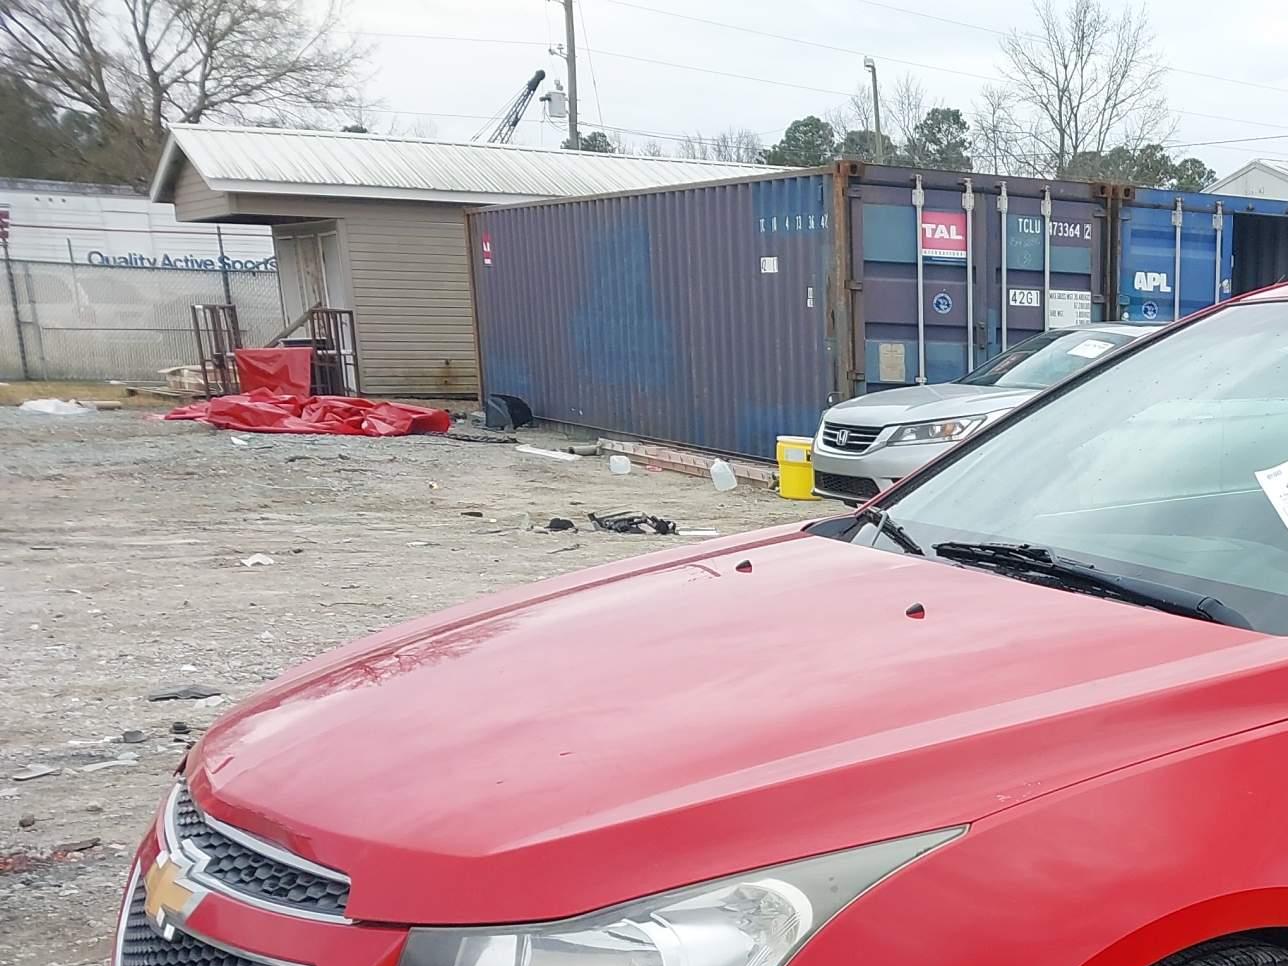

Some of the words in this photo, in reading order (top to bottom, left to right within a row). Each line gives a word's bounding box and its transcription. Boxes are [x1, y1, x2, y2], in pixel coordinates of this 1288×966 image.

[921, 223, 963, 240] TAL
[1017, 218, 1041, 234] TCLU
[87, 251, 157, 271] Quality
[160, 253, 214, 270] Active
[1134, 271, 1171, 292] APL
[1011, 291, 1039, 305] 42G1
